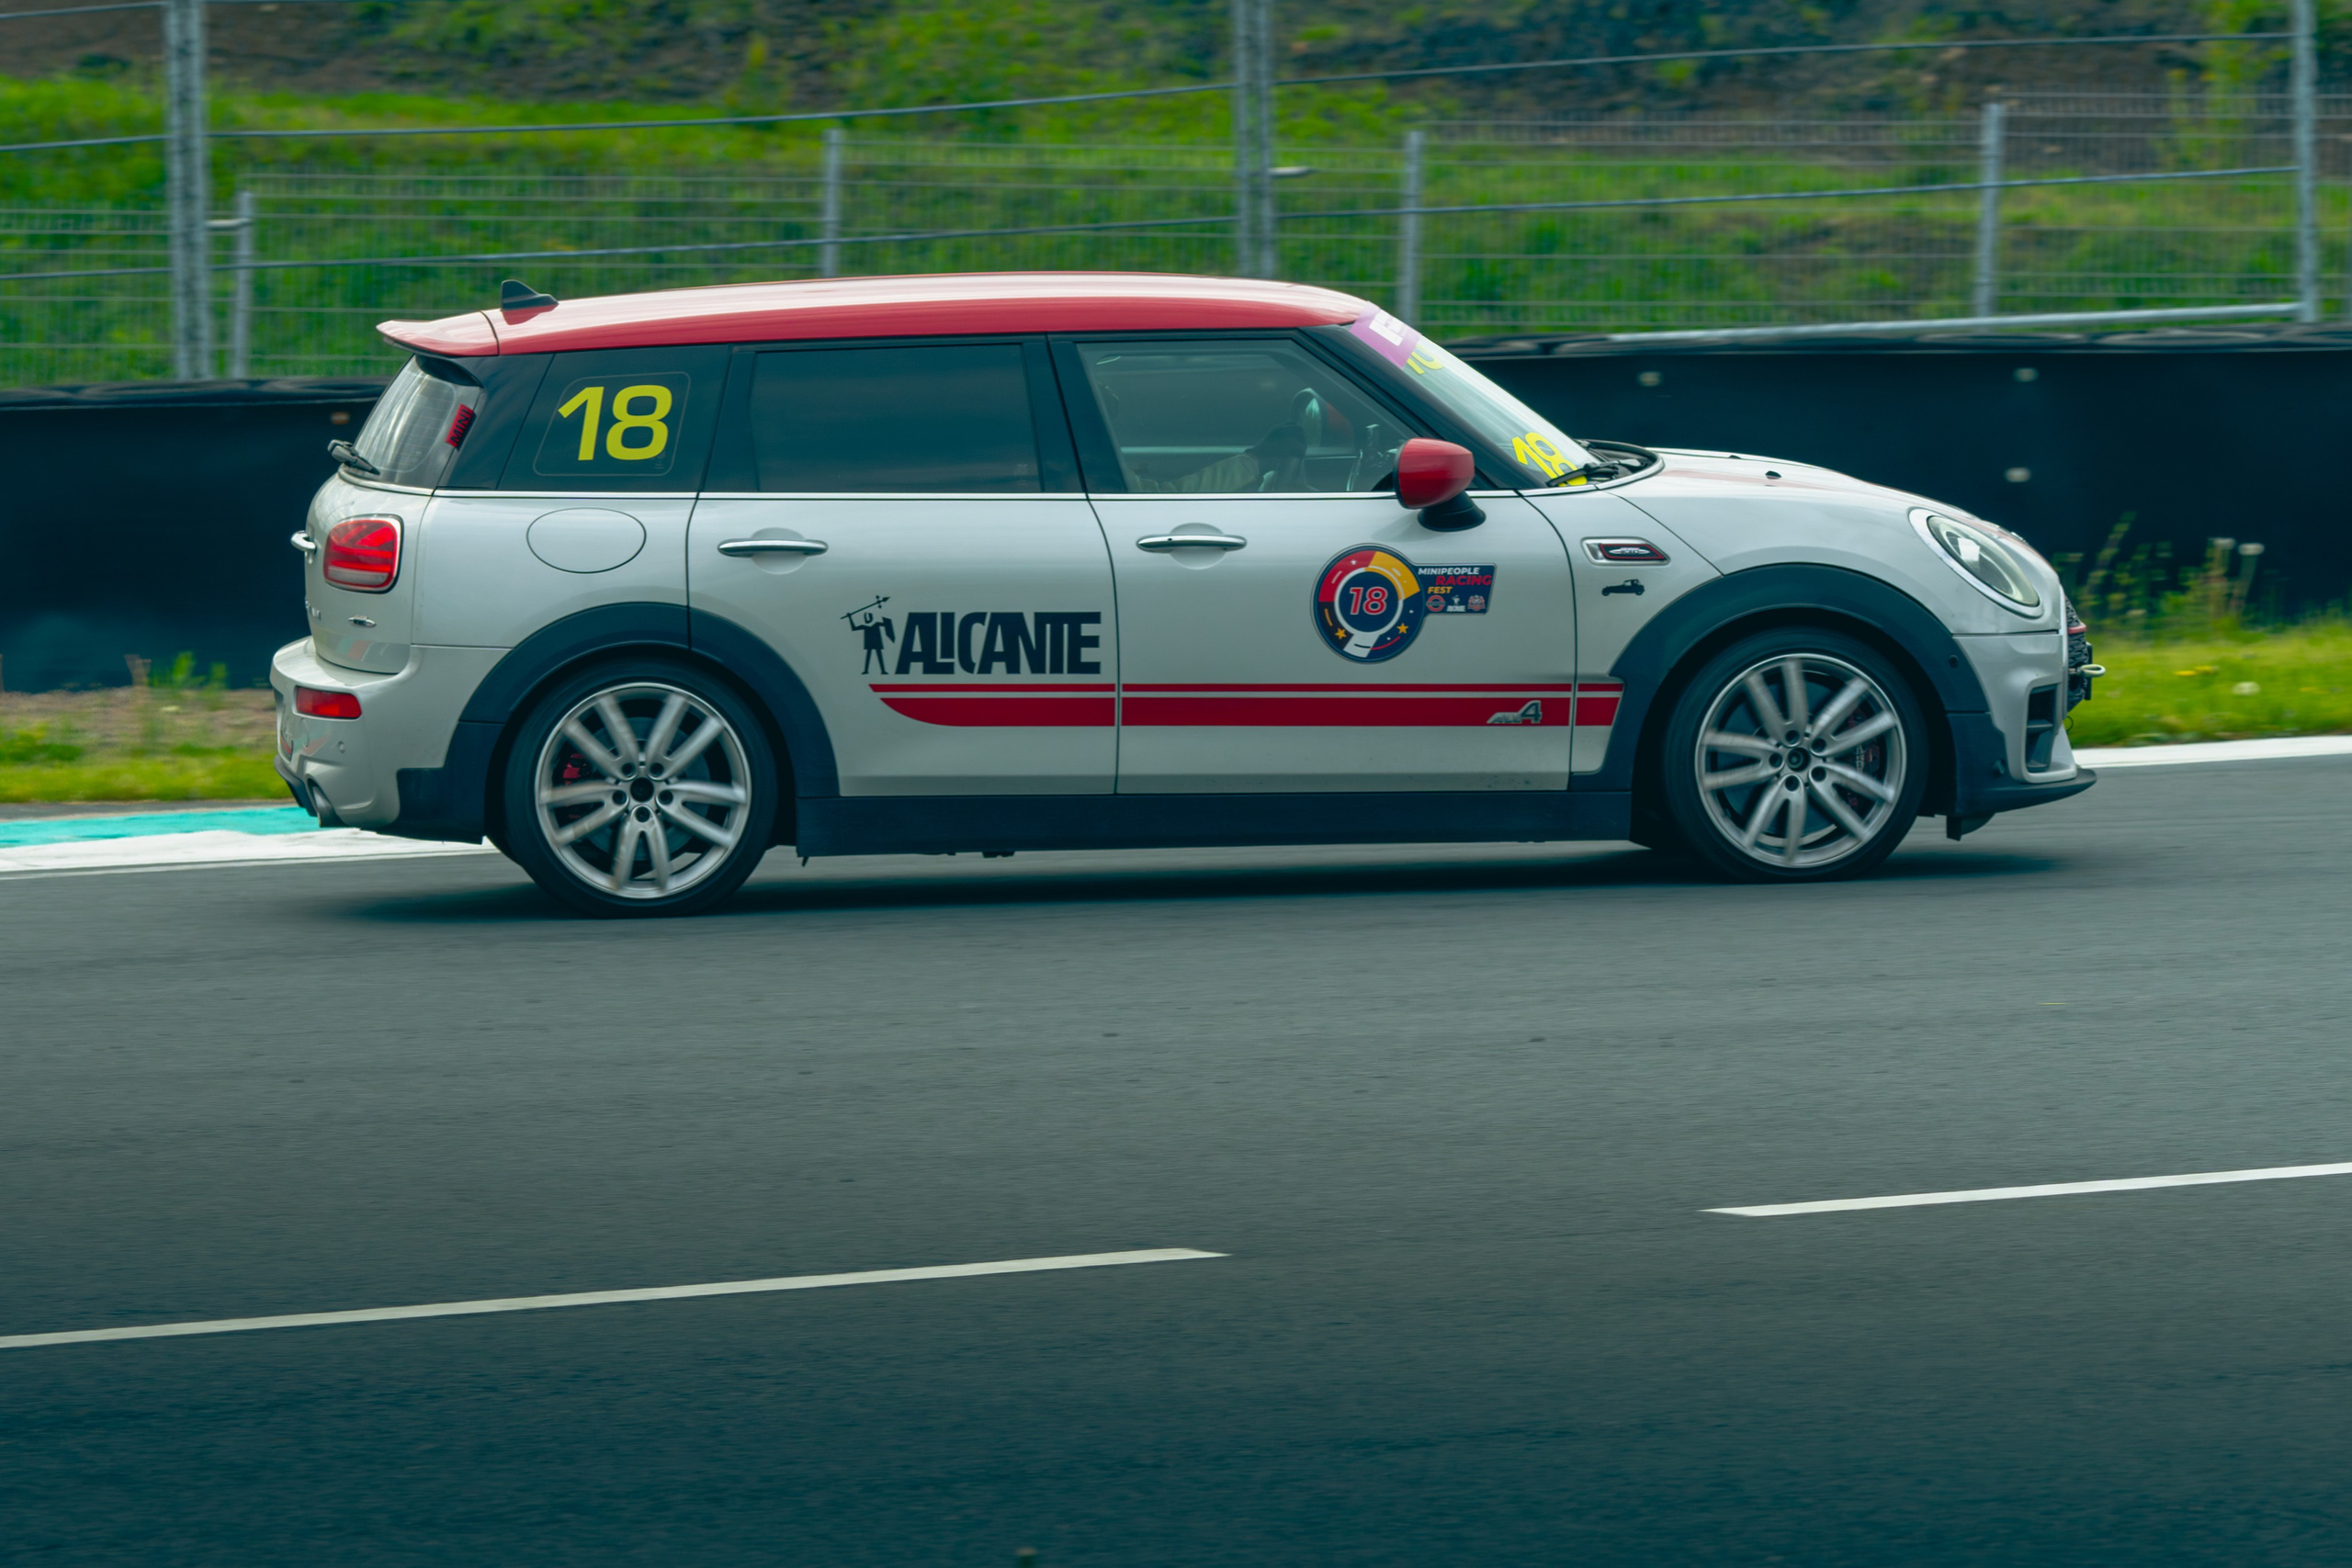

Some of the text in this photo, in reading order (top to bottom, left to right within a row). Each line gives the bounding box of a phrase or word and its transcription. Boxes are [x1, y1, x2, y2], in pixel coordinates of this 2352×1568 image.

[450, 408, 470, 446] MINI
[558, 384, 673, 461] 18
[1511, 432, 1588, 487] 18
[1418, 567, 1480, 576] MINIPEOPLE
[1435, 575, 1492, 586] RACING
[1350, 586, 1388, 615] 18
[1427, 586, 1453, 594] FEST
[894, 611, 1102, 675] ALICANTE
